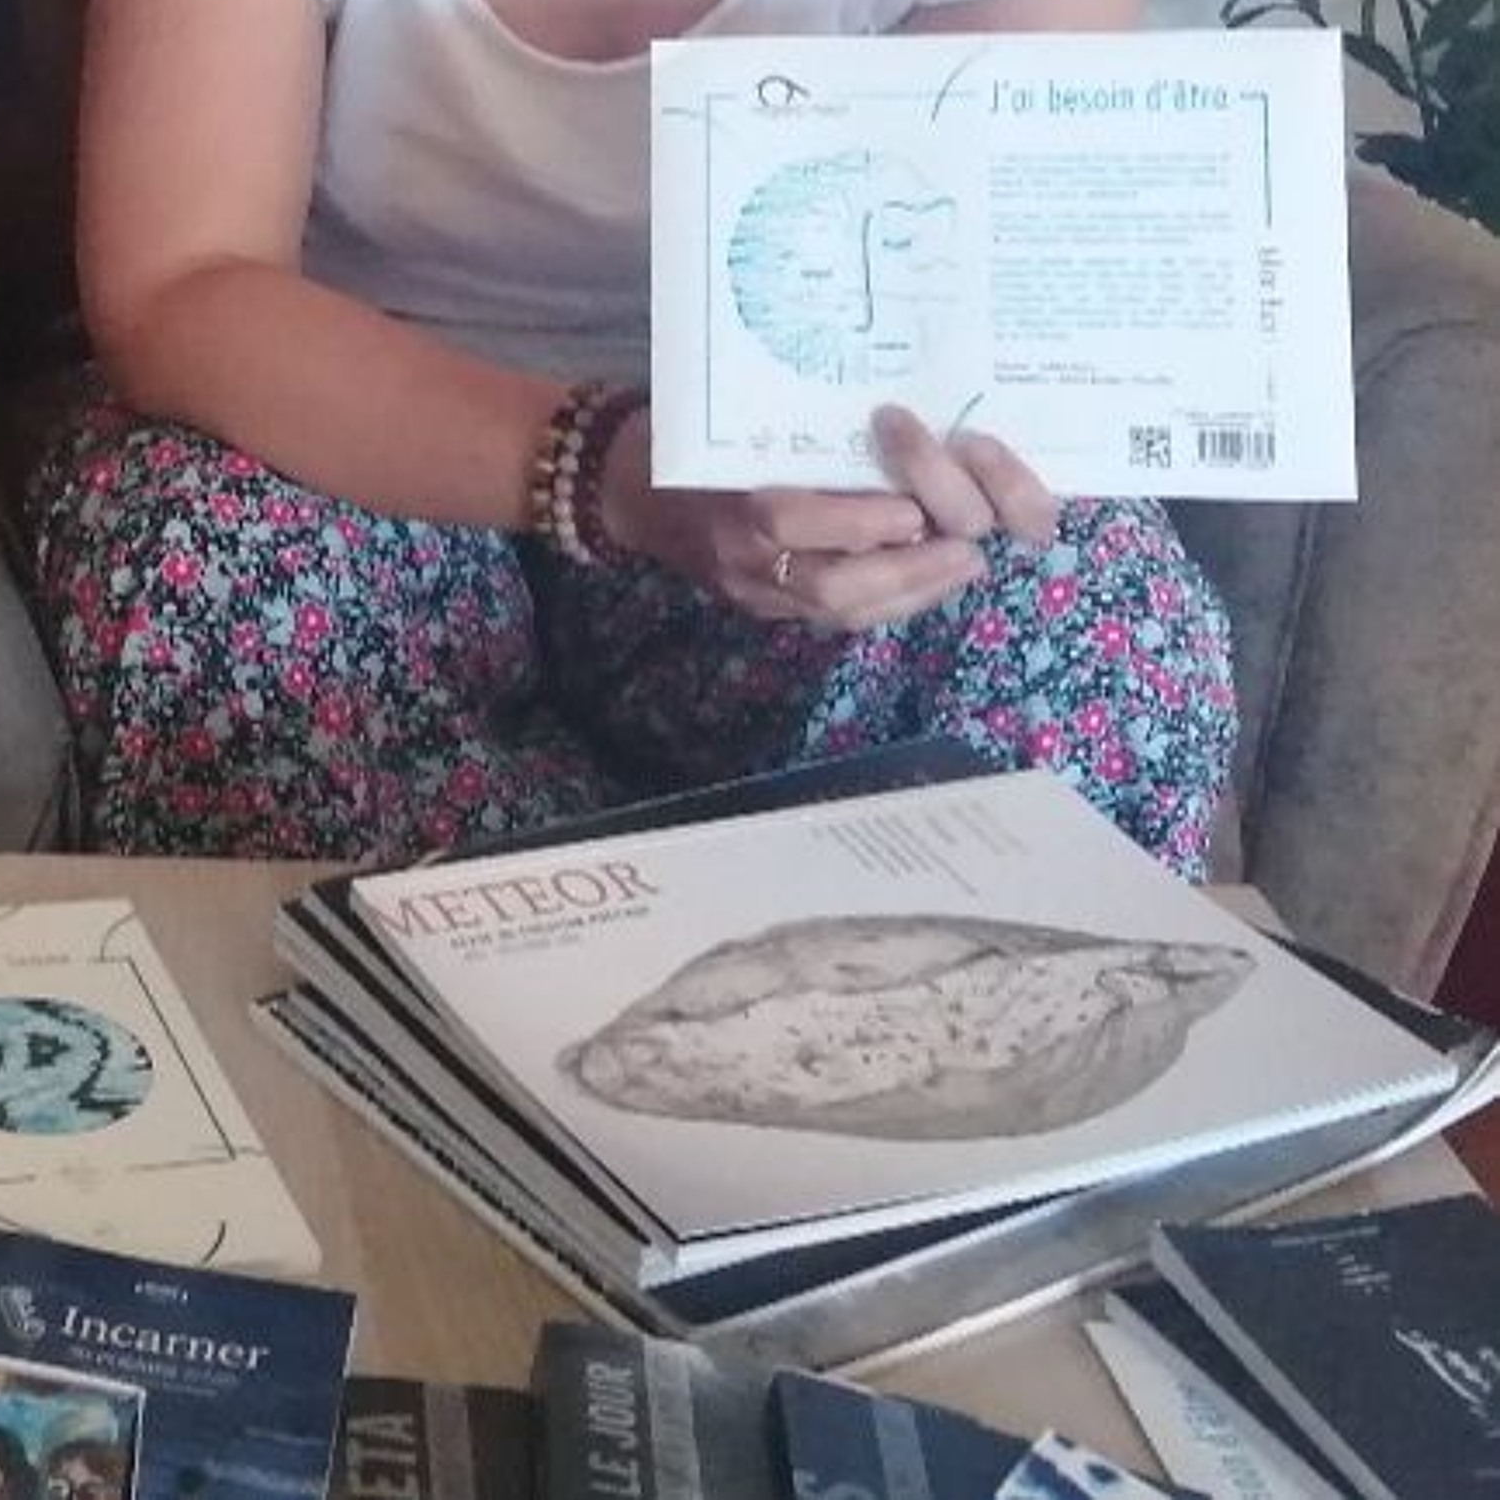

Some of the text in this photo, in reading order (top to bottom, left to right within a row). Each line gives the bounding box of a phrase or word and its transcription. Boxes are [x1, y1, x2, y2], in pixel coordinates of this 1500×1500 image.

[1048, 79, 1135, 112] besoin
[367, 861, 659, 938] METEOR
[62, 1306, 270, 1370] Incarner
[586, 1360, 642, 1497] LE JOUR
